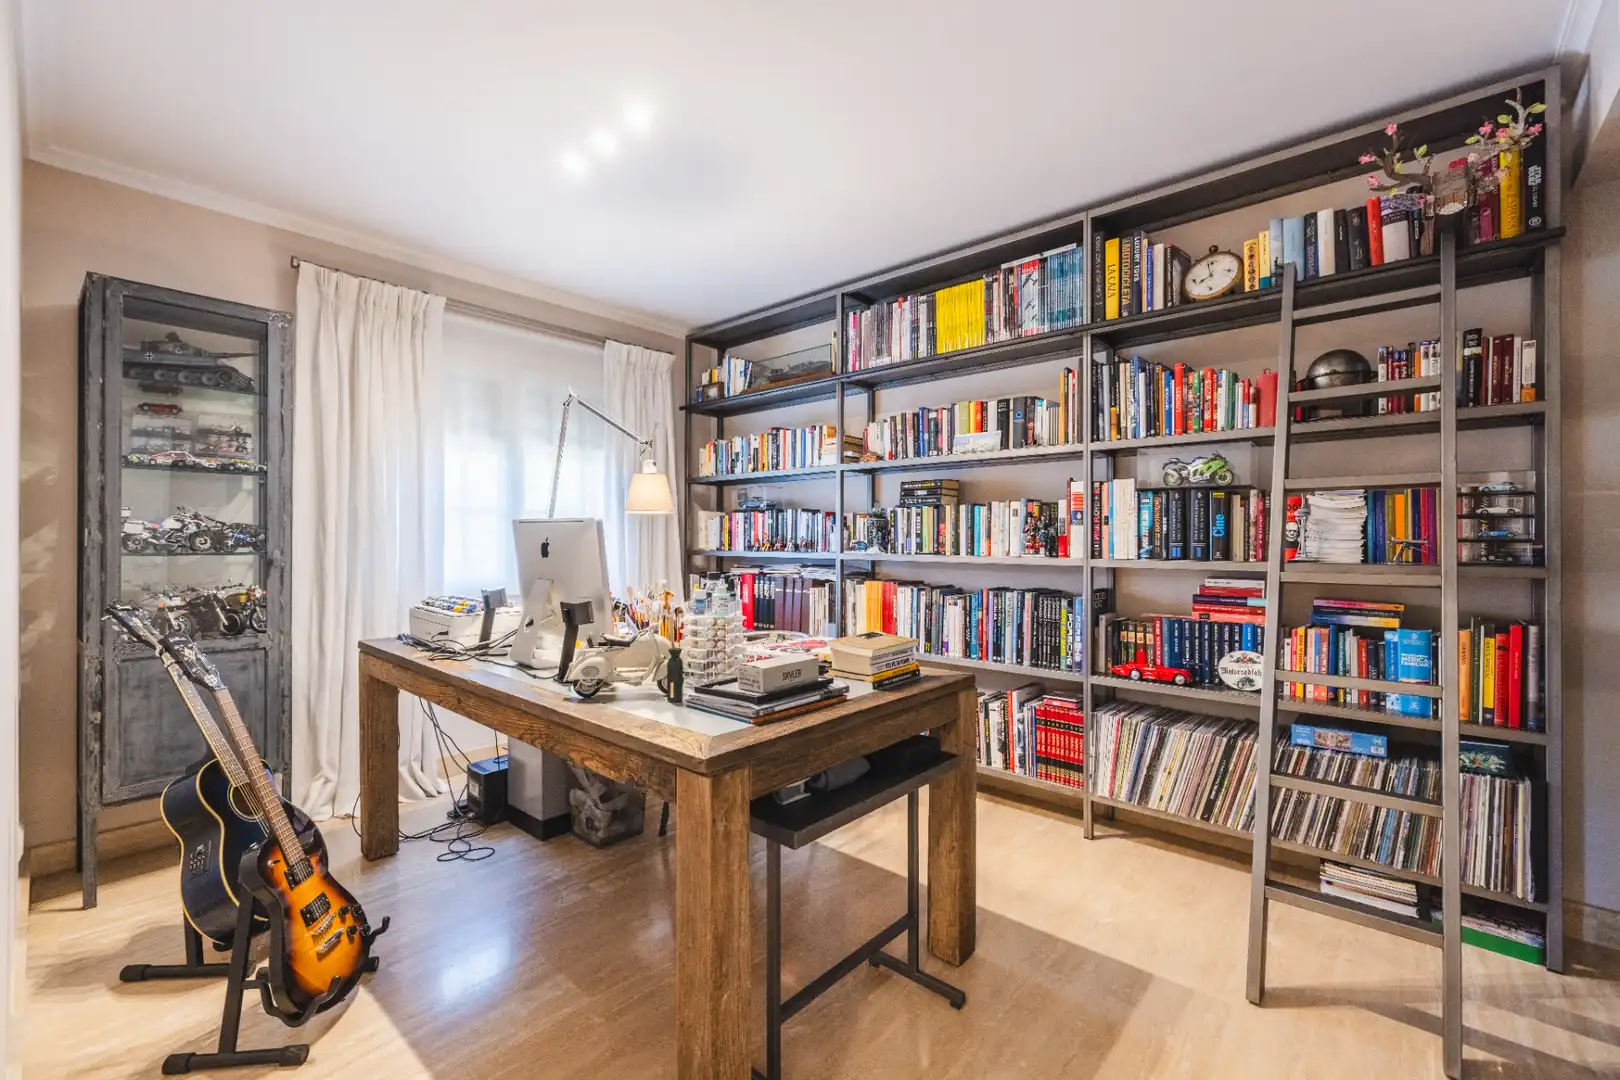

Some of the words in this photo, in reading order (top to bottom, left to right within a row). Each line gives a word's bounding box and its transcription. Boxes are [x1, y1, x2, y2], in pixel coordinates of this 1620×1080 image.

[1122, 243, 1131, 305] MOTOCICLETA
[1212, 514, 1225, 537] Cine
[782, 669, 802, 681] SKYLER
